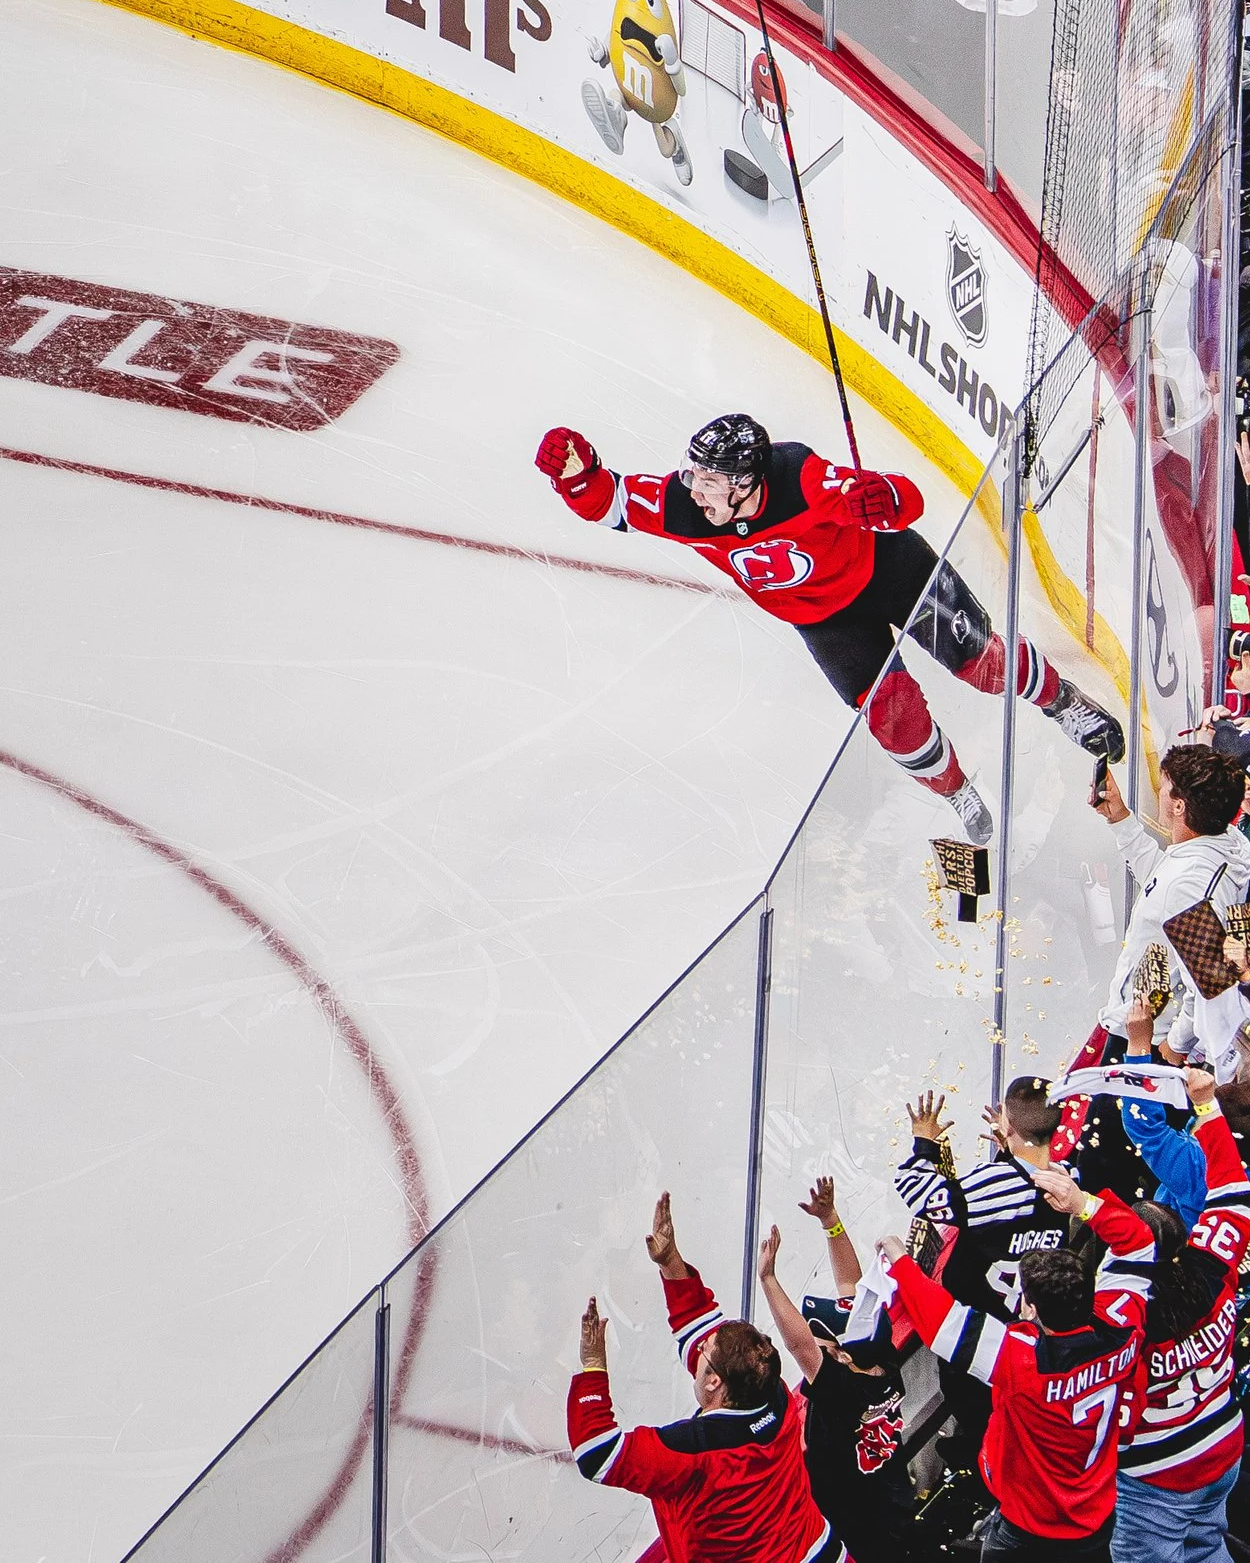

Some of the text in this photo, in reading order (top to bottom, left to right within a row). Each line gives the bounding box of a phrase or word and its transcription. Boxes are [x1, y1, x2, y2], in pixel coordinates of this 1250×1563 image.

[954, 273, 982, 306] NHL
[749, 1411, 777, 1435] Reebok
[1072, 1383, 1118, 1470] 7
